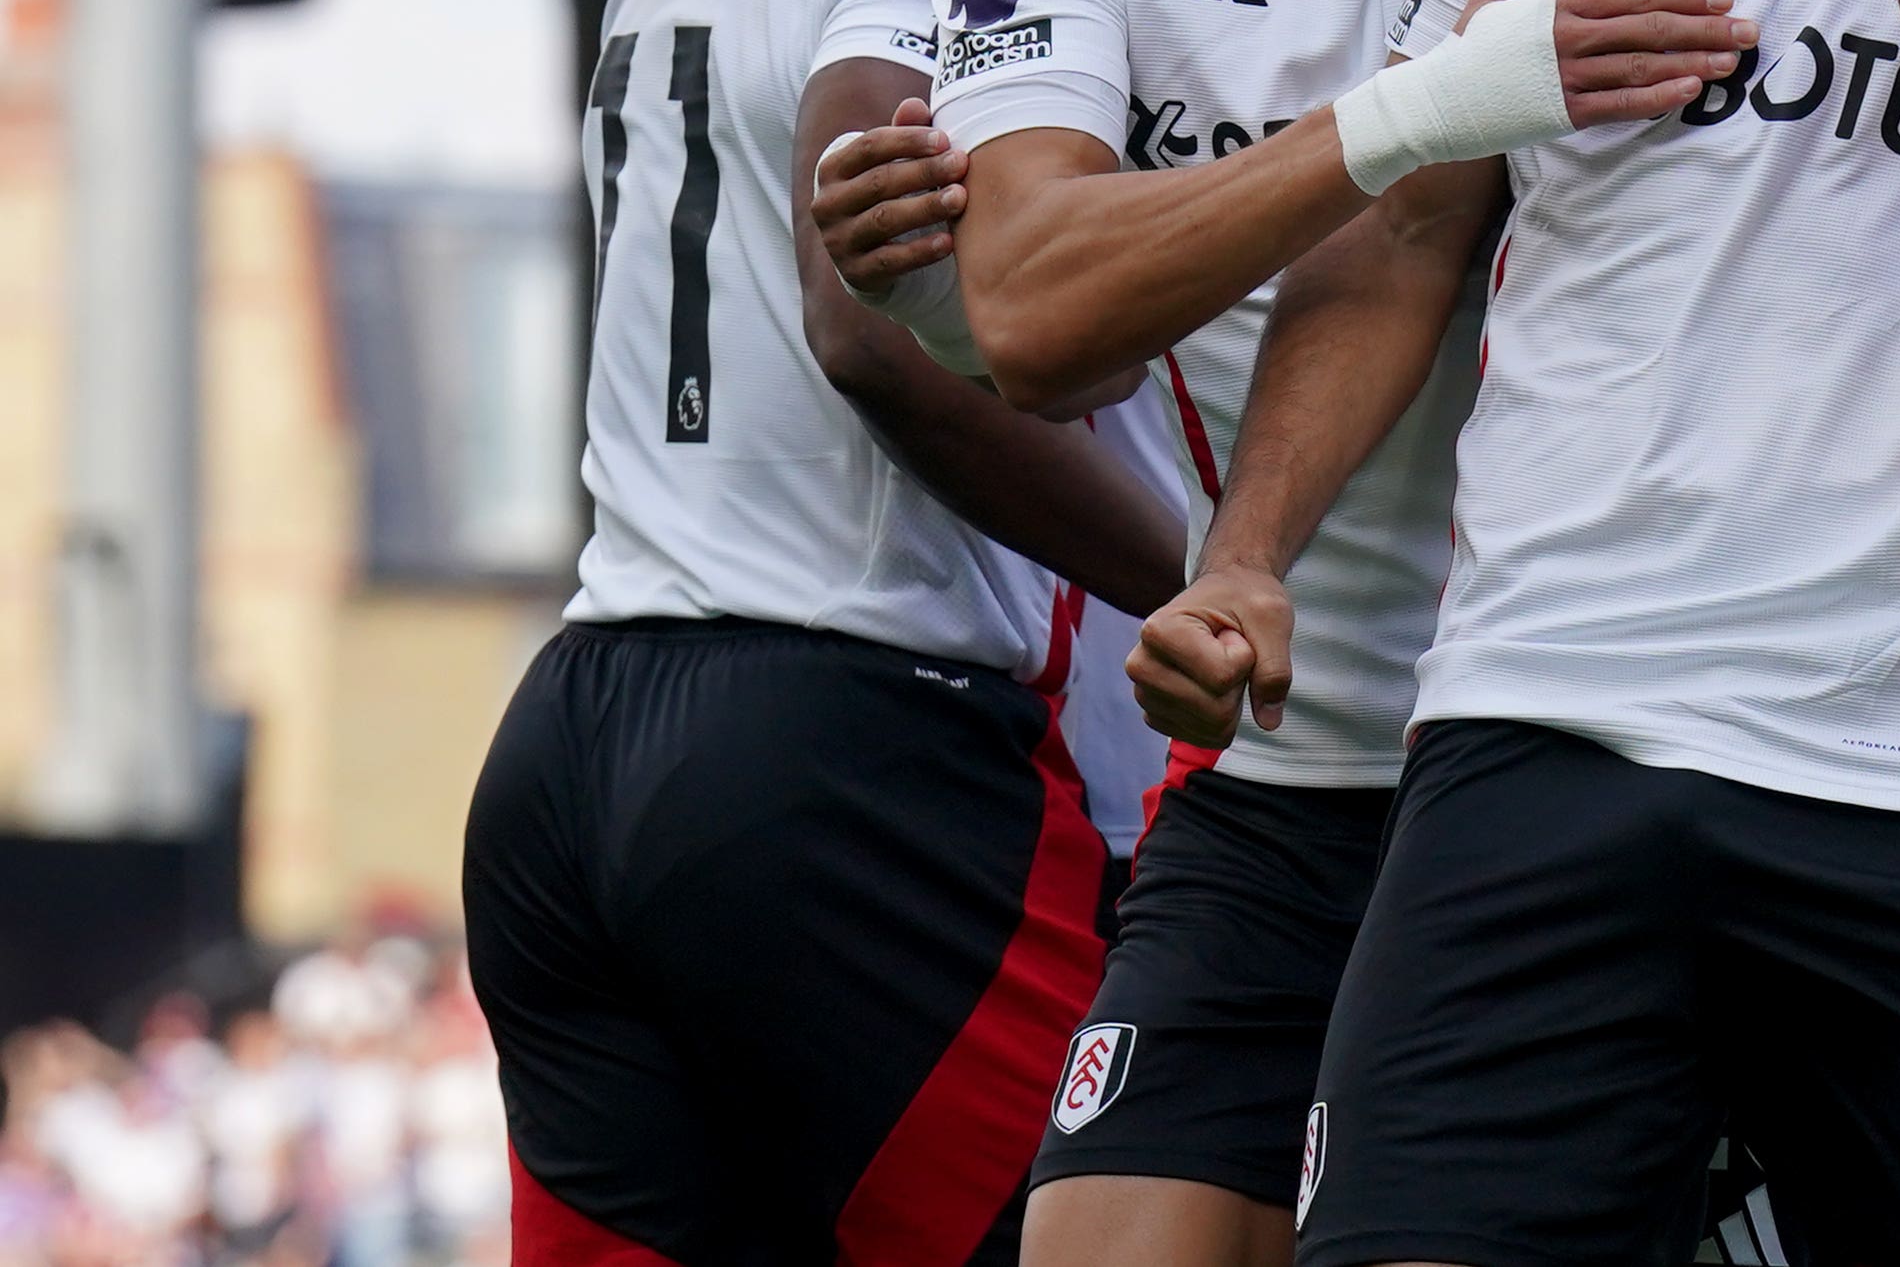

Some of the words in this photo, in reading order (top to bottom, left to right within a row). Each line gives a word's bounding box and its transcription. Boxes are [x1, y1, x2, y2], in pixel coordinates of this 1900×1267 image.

[963, 40, 1052, 76] racism
[964, 26, 1038, 57] room
[591, 26, 720, 444] 11
[1067, 1037, 1110, 1110] FFC
